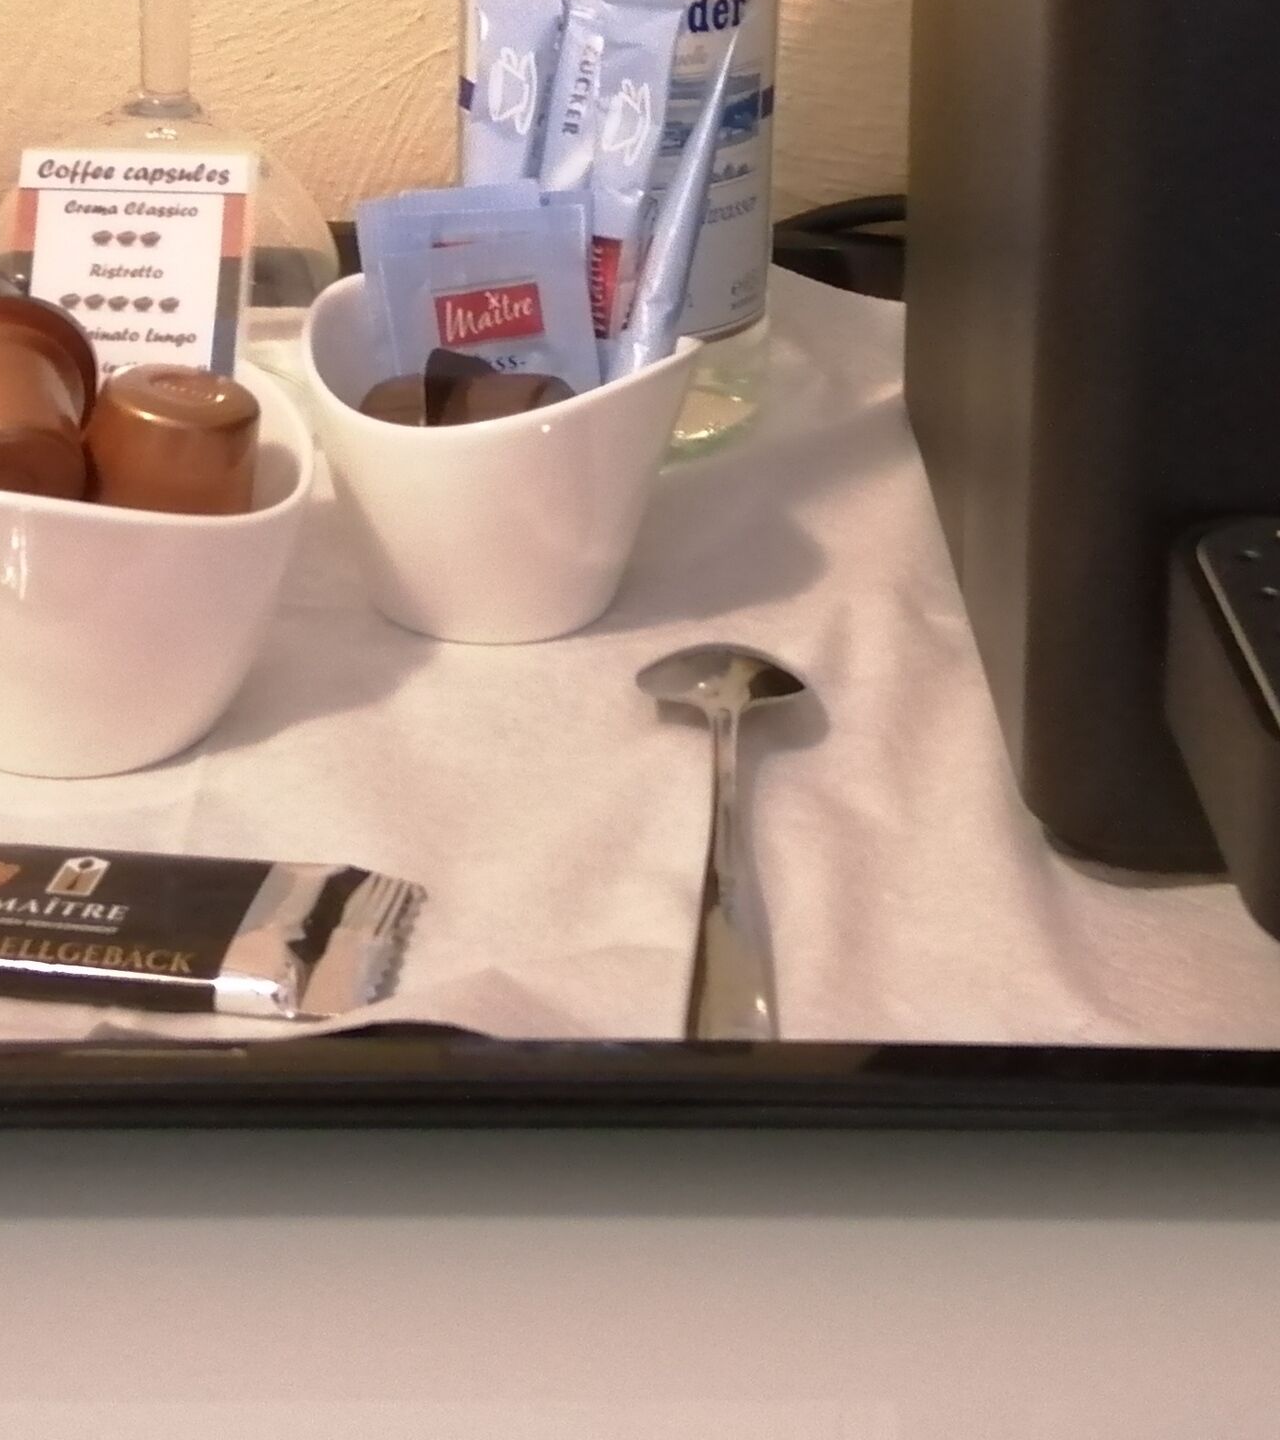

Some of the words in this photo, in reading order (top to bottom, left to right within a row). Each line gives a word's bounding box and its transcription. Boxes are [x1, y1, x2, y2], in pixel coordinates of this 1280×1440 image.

[37, 159, 115, 185] Coffee
[122, 163, 231, 186] capsules
[63, 199, 119, 216] Crema
[123, 201, 199, 218] Classico
[88, 263, 164, 280] Ristretto
